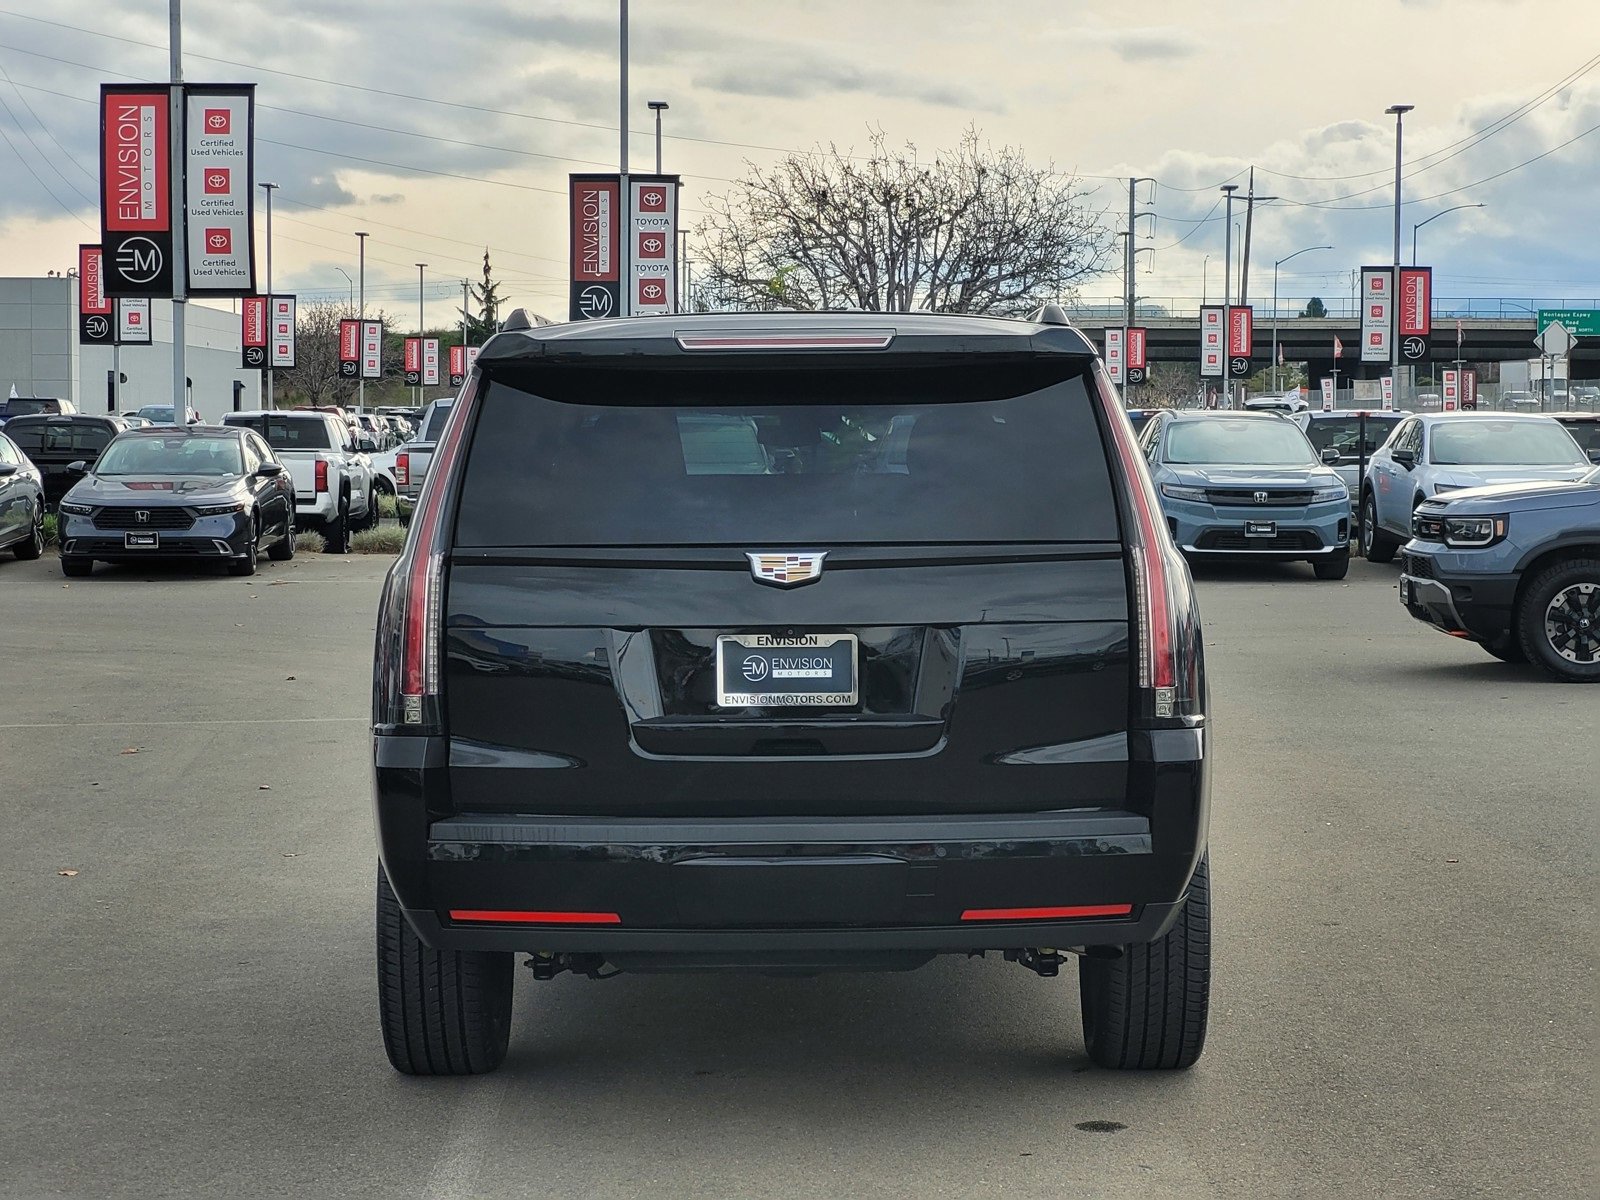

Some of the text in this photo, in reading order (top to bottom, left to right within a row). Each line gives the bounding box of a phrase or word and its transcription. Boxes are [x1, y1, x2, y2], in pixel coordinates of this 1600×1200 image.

[118, 105, 138, 220] ENVISION
[144, 116, 152, 210] MOTORS
[583, 190, 598, 273] ENVISION
[88, 254, 98, 309] ENVISION
[1406, 276, 1416, 330] ENVISION
[757, 636, 818, 646] ENVISION
[772, 658, 832, 669] ENVISION
[724, 696, 851, 704] ENVISIONMOTORS.COM
